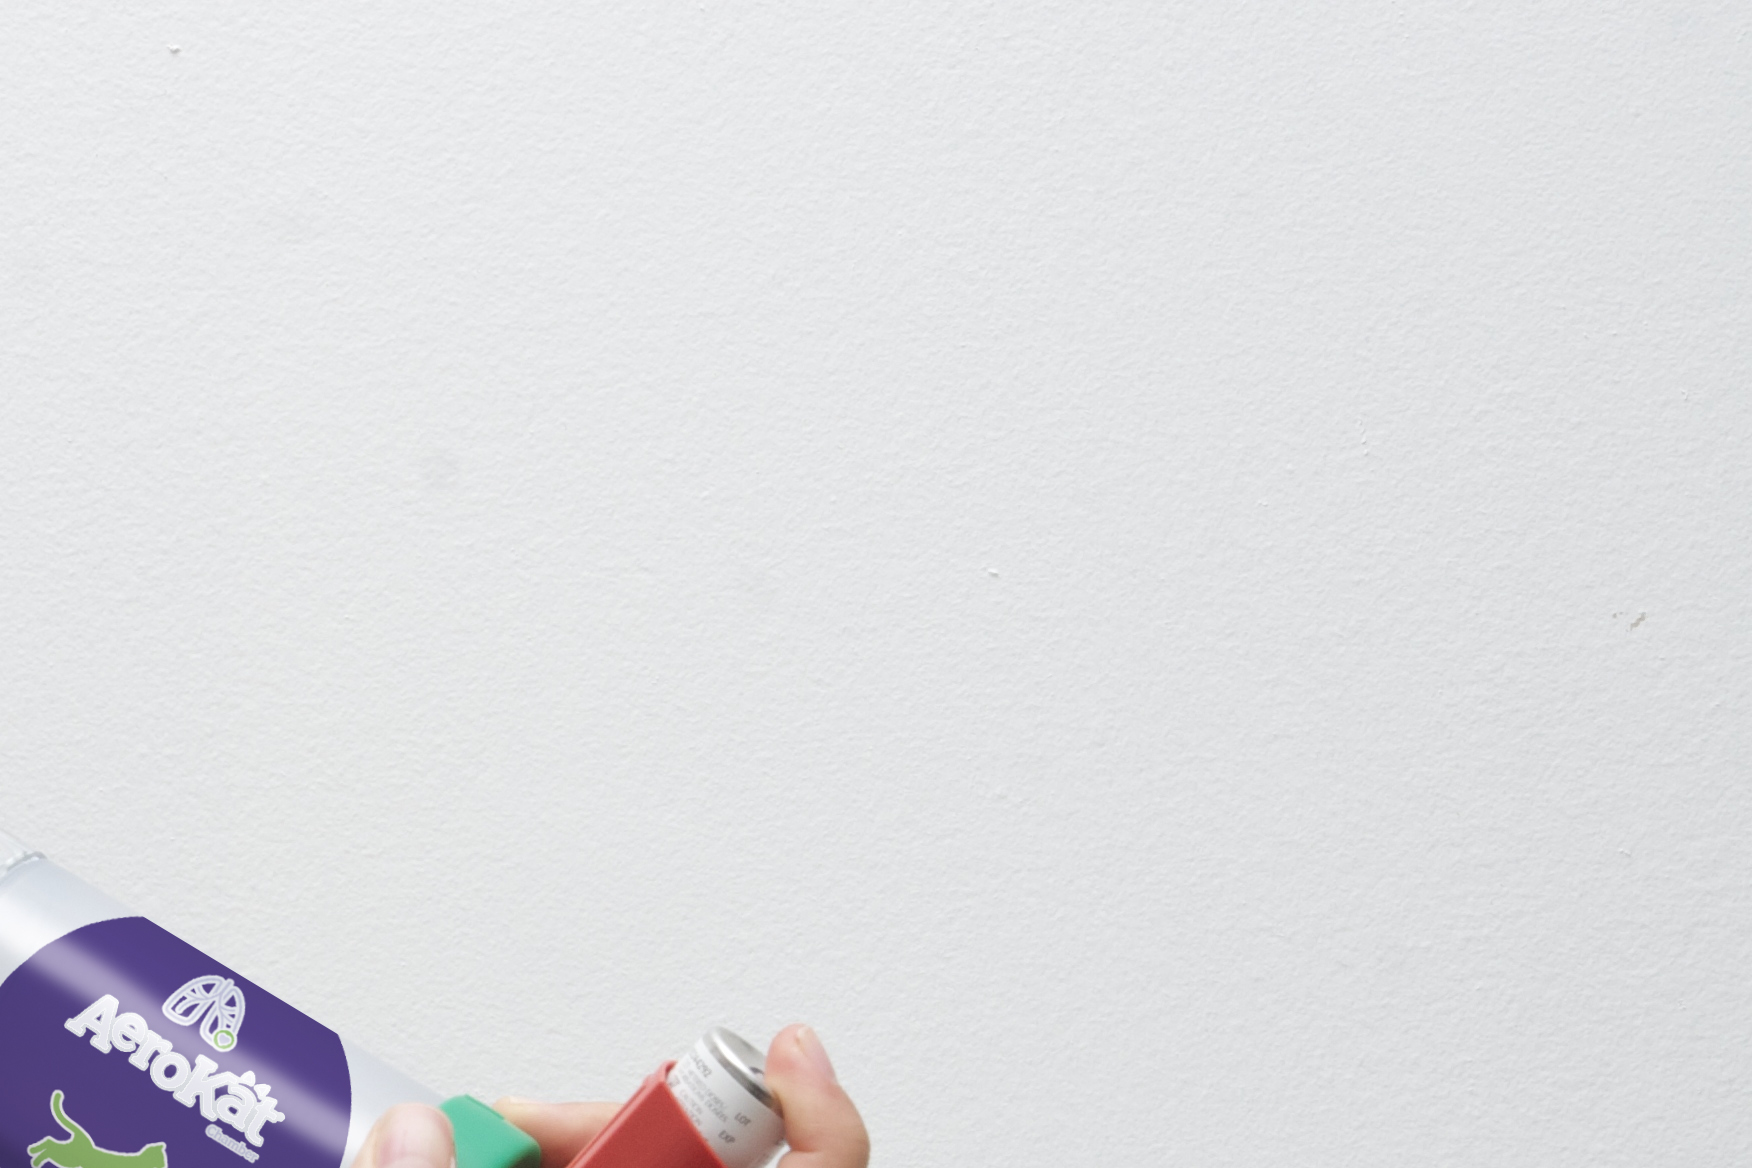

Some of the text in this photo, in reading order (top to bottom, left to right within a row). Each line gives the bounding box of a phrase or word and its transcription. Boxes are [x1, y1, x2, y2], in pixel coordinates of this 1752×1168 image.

[734, 1112, 751, 1126] LOT
[205, 1124, 260, 1163] Chamber
[718, 1130, 736, 1143] EXP
